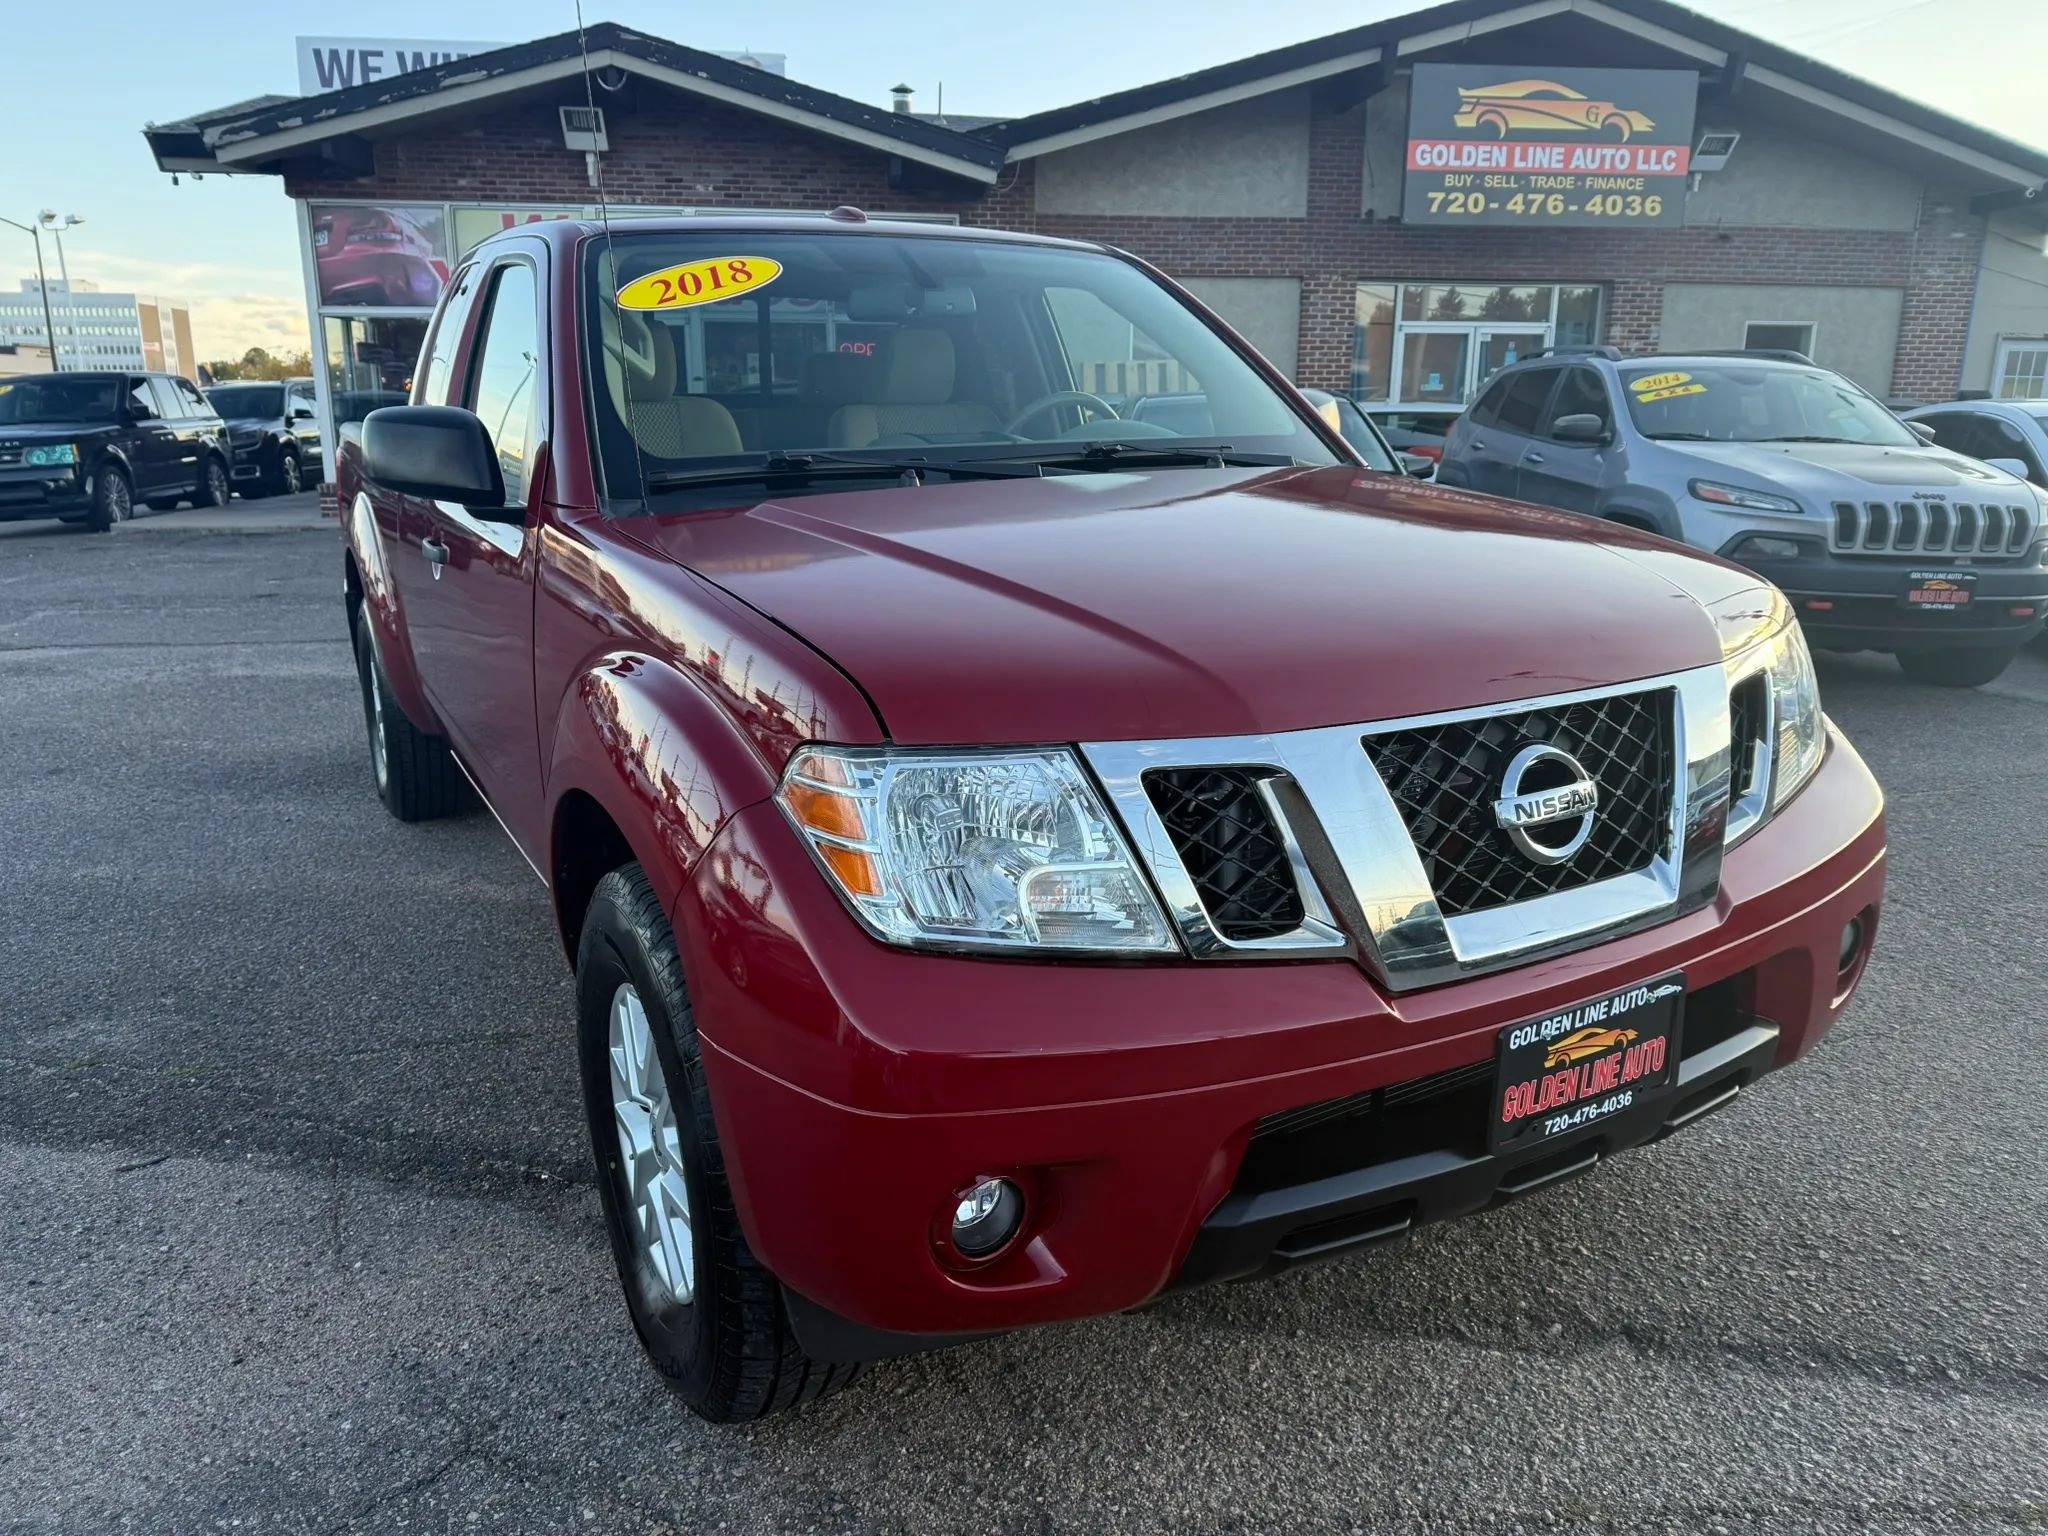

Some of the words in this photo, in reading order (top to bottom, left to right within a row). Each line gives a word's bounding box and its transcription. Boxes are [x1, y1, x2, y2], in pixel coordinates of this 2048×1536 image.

[1415, 144, 1507, 168] GOLDEN
[1514, 146, 1564, 169] LINE
[1571, 148, 1630, 170] AUTO
[1637, 150, 1677, 171] LLC
[1445, 175, 1473, 187] BUY
[1484, 175, 1518, 188] SELL
[1530, 176, 1575, 189] TRADE
[1585, 177, 1644, 190] FINANCE
[651, 260, 753, 305] 2018
[1643, 374, 1680, 389] 2014
[1912, 492, 1946, 501] Jeep
[1514, 786, 1595, 821] NISSAN
[1509, 1012, 1573, 1050] GOLDEN
[1575, 1001, 1609, 1028] LINE
[1610, 987, 1648, 1017] AUTO
[1502, 1064, 1580, 1123] GOLDEN
[1580, 1051, 1622, 1098] LINE
[1620, 1036, 1666, 1085] AUTO
[1545, 1090, 1633, 1136] 720-476-4036
